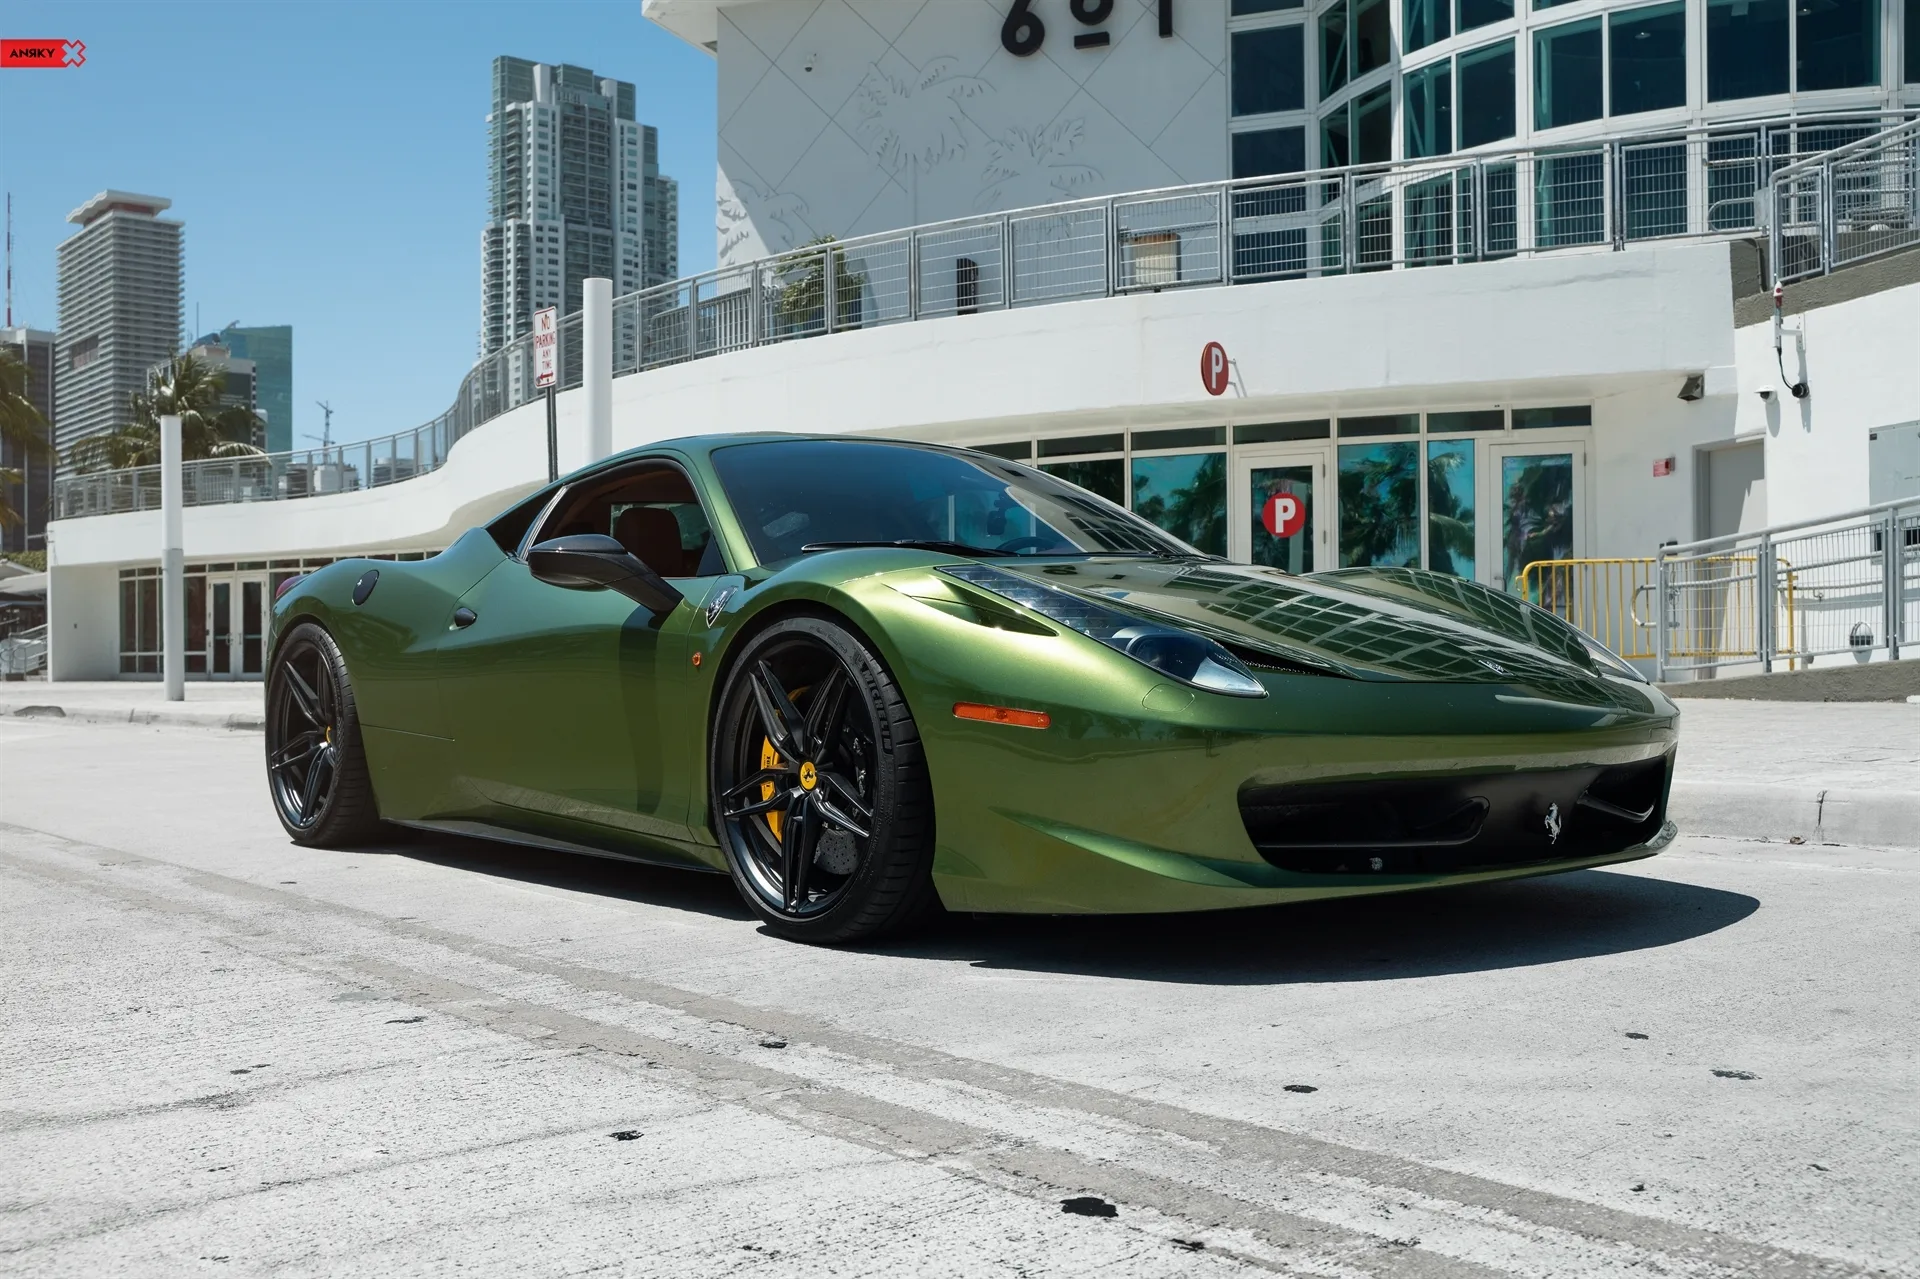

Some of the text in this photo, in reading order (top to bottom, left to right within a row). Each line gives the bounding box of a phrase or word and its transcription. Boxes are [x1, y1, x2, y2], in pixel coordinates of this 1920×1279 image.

[541, 316, 550, 331] NO
[535, 331, 556, 349] PARKING
[543, 349, 551, 358] ANY
[541, 359, 552, 370] TIME
[1211, 347, 1223, 389] P
[1275, 498, 1296, 533] P
[862, 668, 893, 751] MICHELIN
